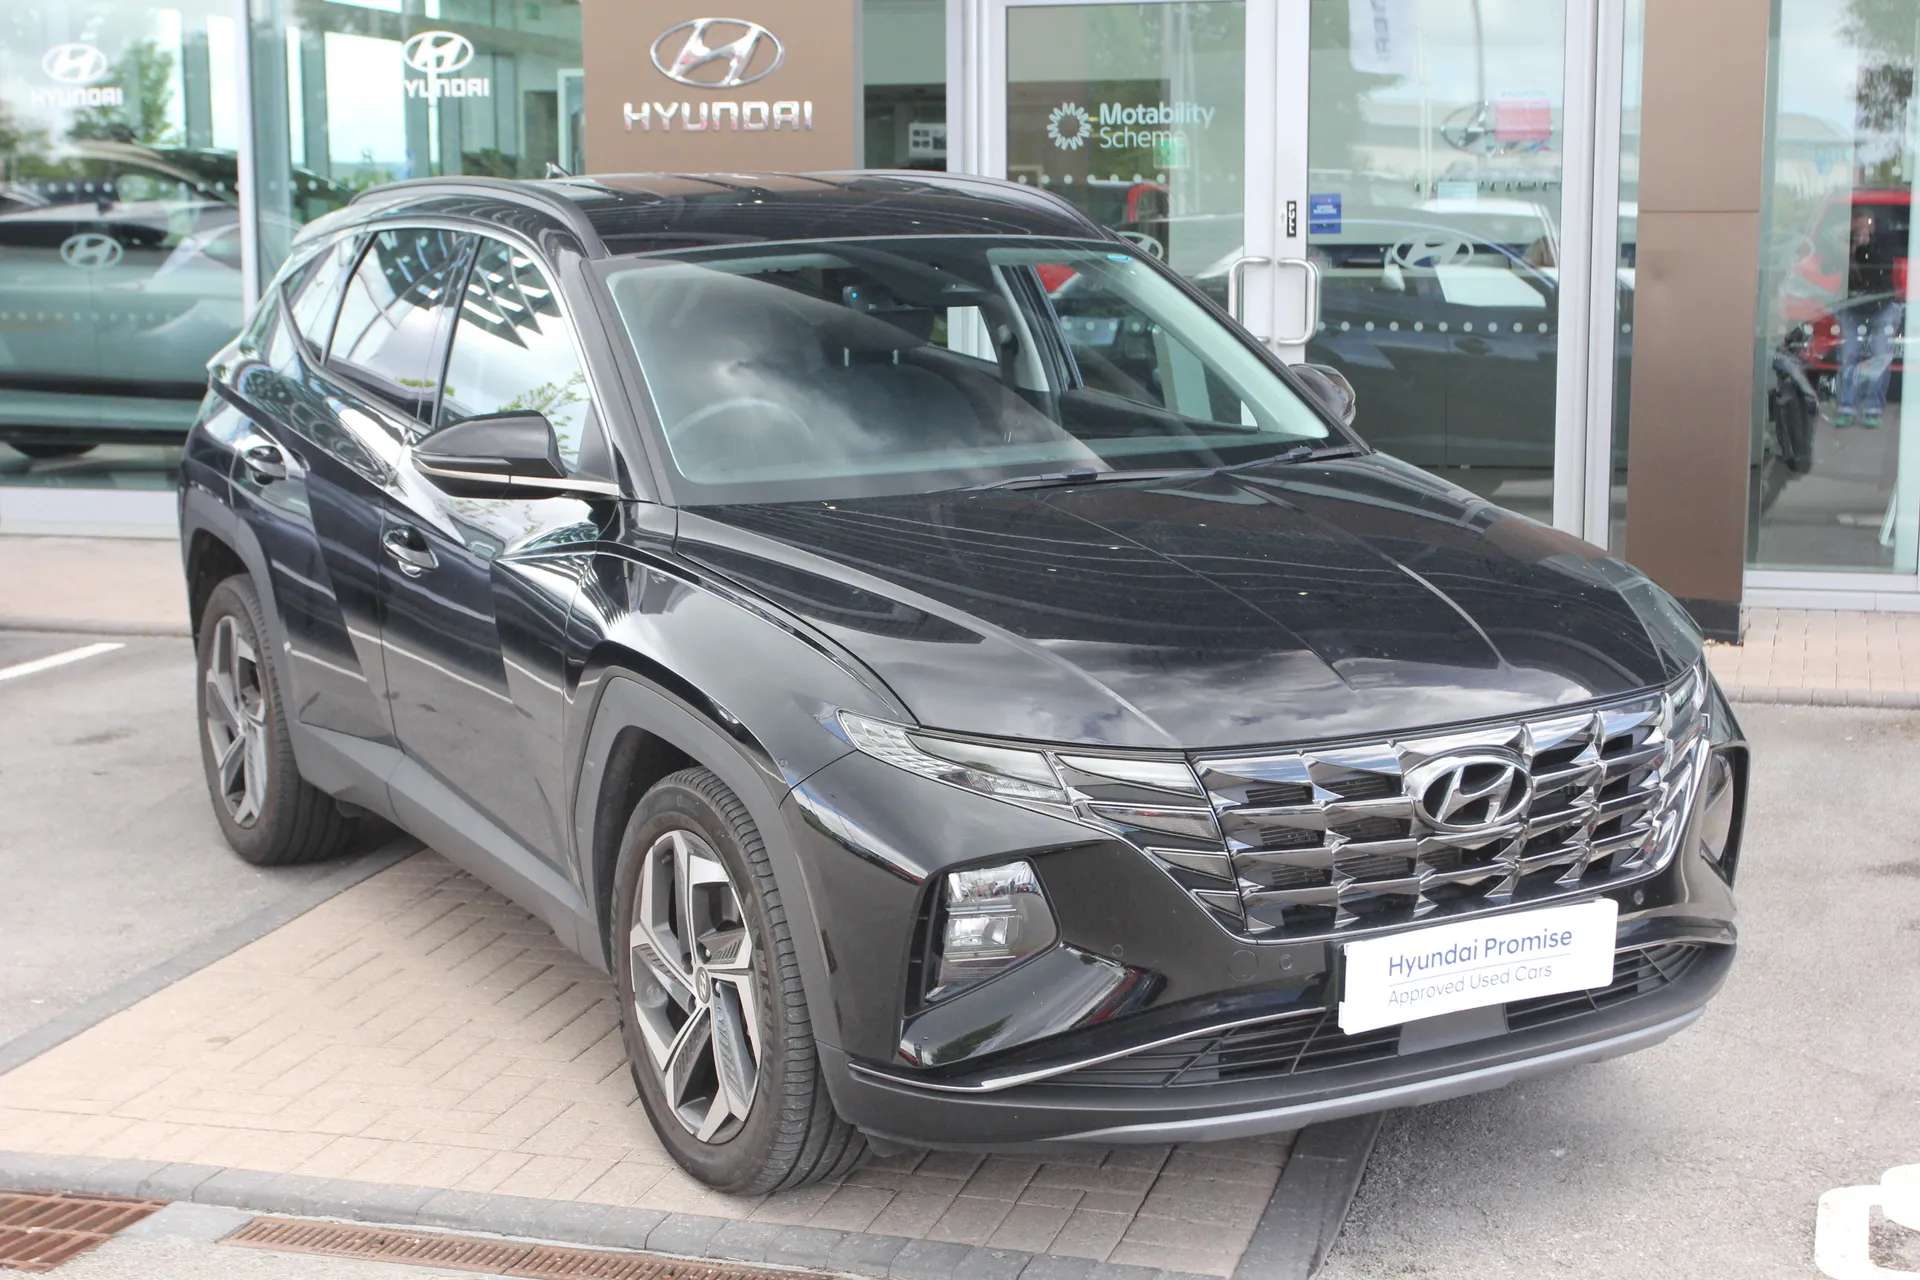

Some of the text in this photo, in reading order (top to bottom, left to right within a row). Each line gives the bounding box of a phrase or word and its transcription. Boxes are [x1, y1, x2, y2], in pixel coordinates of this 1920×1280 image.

[399, 78, 490, 98] YUNDAI
[623, 100, 813, 132] HYUNDAI
[1100, 101, 1216, 129] Motability
[1100, 126, 1187, 149] Scheme
[1388, 928, 1573, 977] Hyundai Promise
[1388, 965, 1553, 1006] Approved Used Cars
